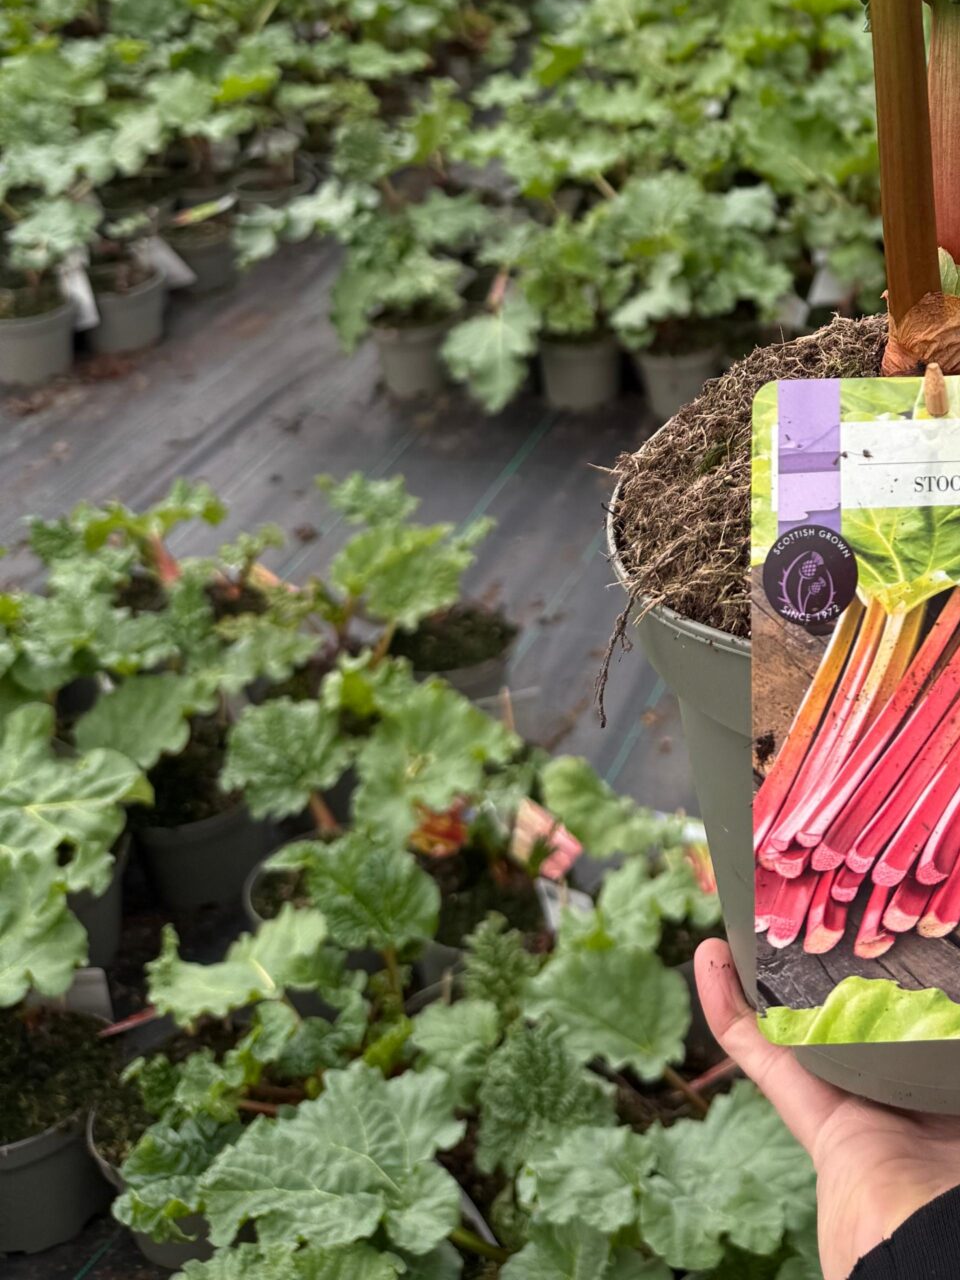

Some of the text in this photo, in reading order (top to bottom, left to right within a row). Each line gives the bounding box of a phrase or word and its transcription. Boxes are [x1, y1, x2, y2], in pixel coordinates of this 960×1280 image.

[773, 528, 851, 558] SCOTTISH GROWN
[780, 604, 840, 622] SINCE 1972
